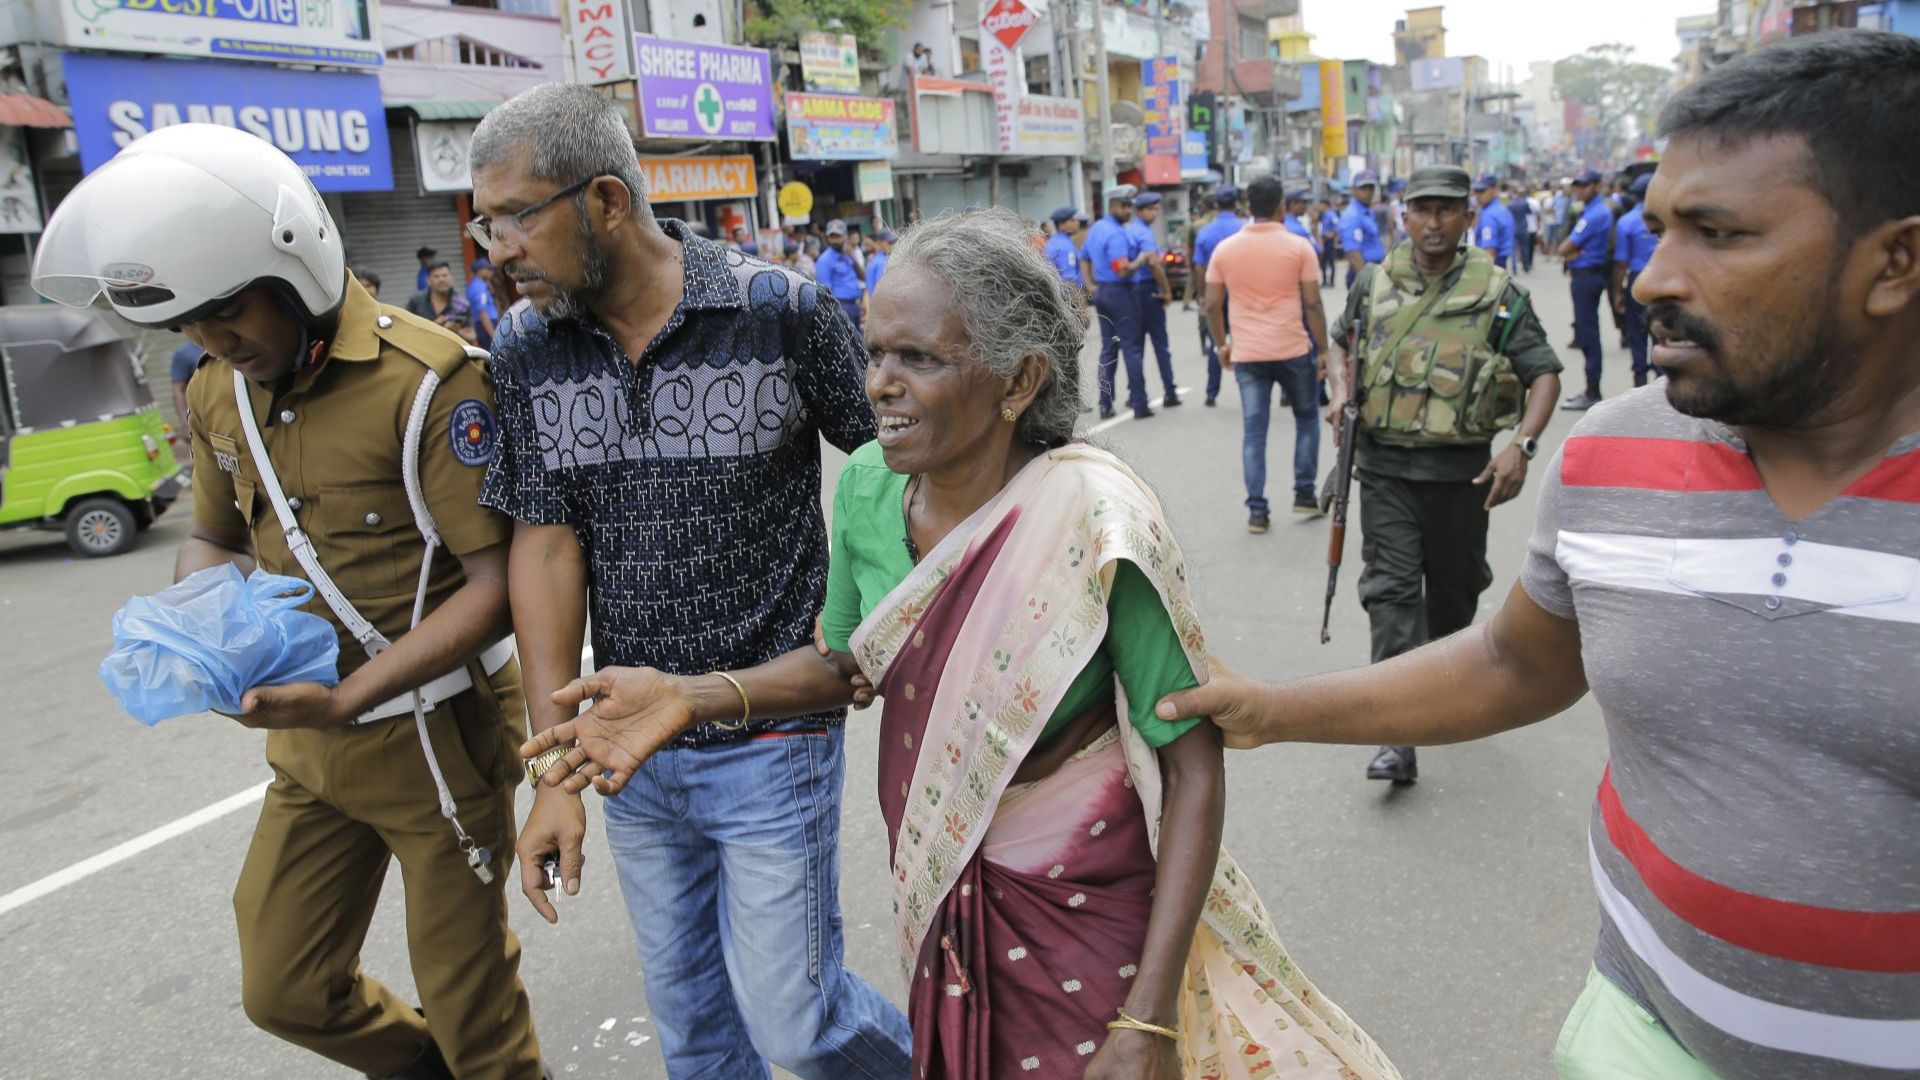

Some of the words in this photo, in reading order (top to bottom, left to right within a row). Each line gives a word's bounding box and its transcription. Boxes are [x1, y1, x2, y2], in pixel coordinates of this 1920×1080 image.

[578, 0, 616, 79] MACY
[640, 44, 697, 79] SHREE
[700, 51, 763, 85] PHARMA
[803, 98, 846, 118] AMMA
[298, 164, 345, 177] EST-ONE
